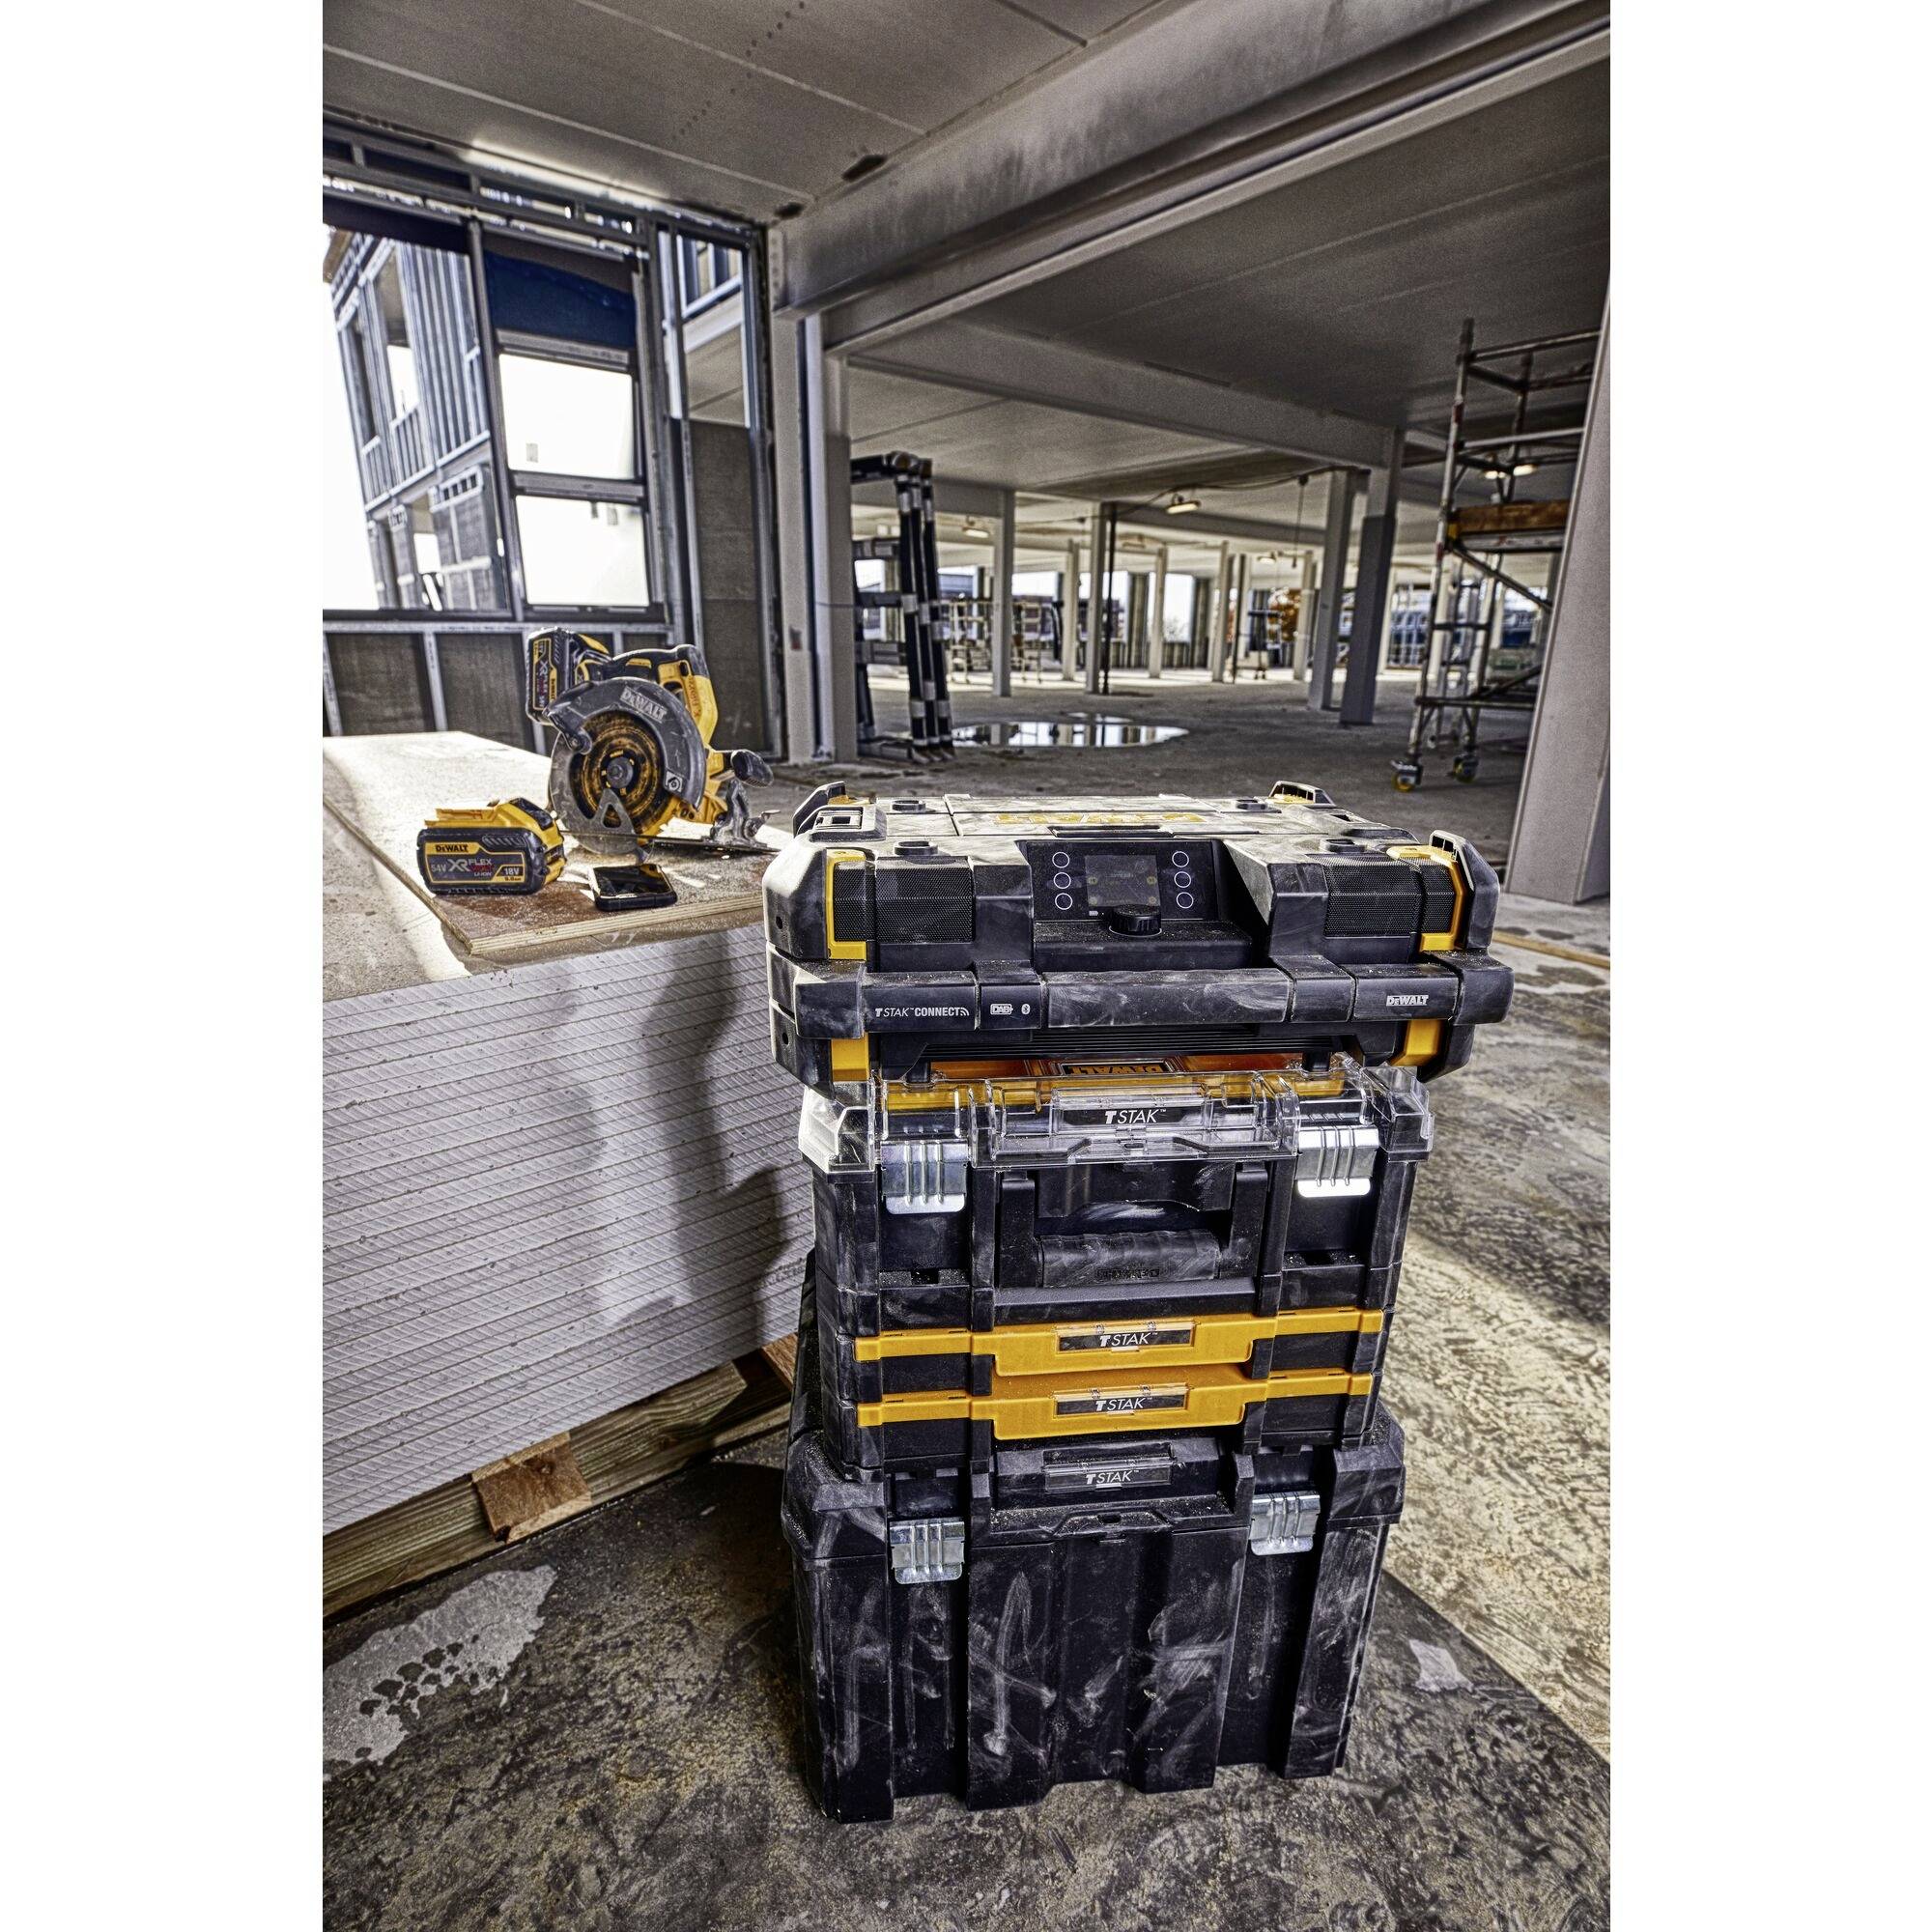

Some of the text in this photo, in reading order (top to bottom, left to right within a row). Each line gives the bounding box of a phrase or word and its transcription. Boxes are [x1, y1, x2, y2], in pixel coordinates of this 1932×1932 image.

[435, 843, 469, 853] DEWALT
[447, 858, 470, 872] XR
[504, 867, 521, 876] 18V
[1385, 994, 1429, 1007] DEWALT
[914, 1007, 961, 1017] CONNECT
